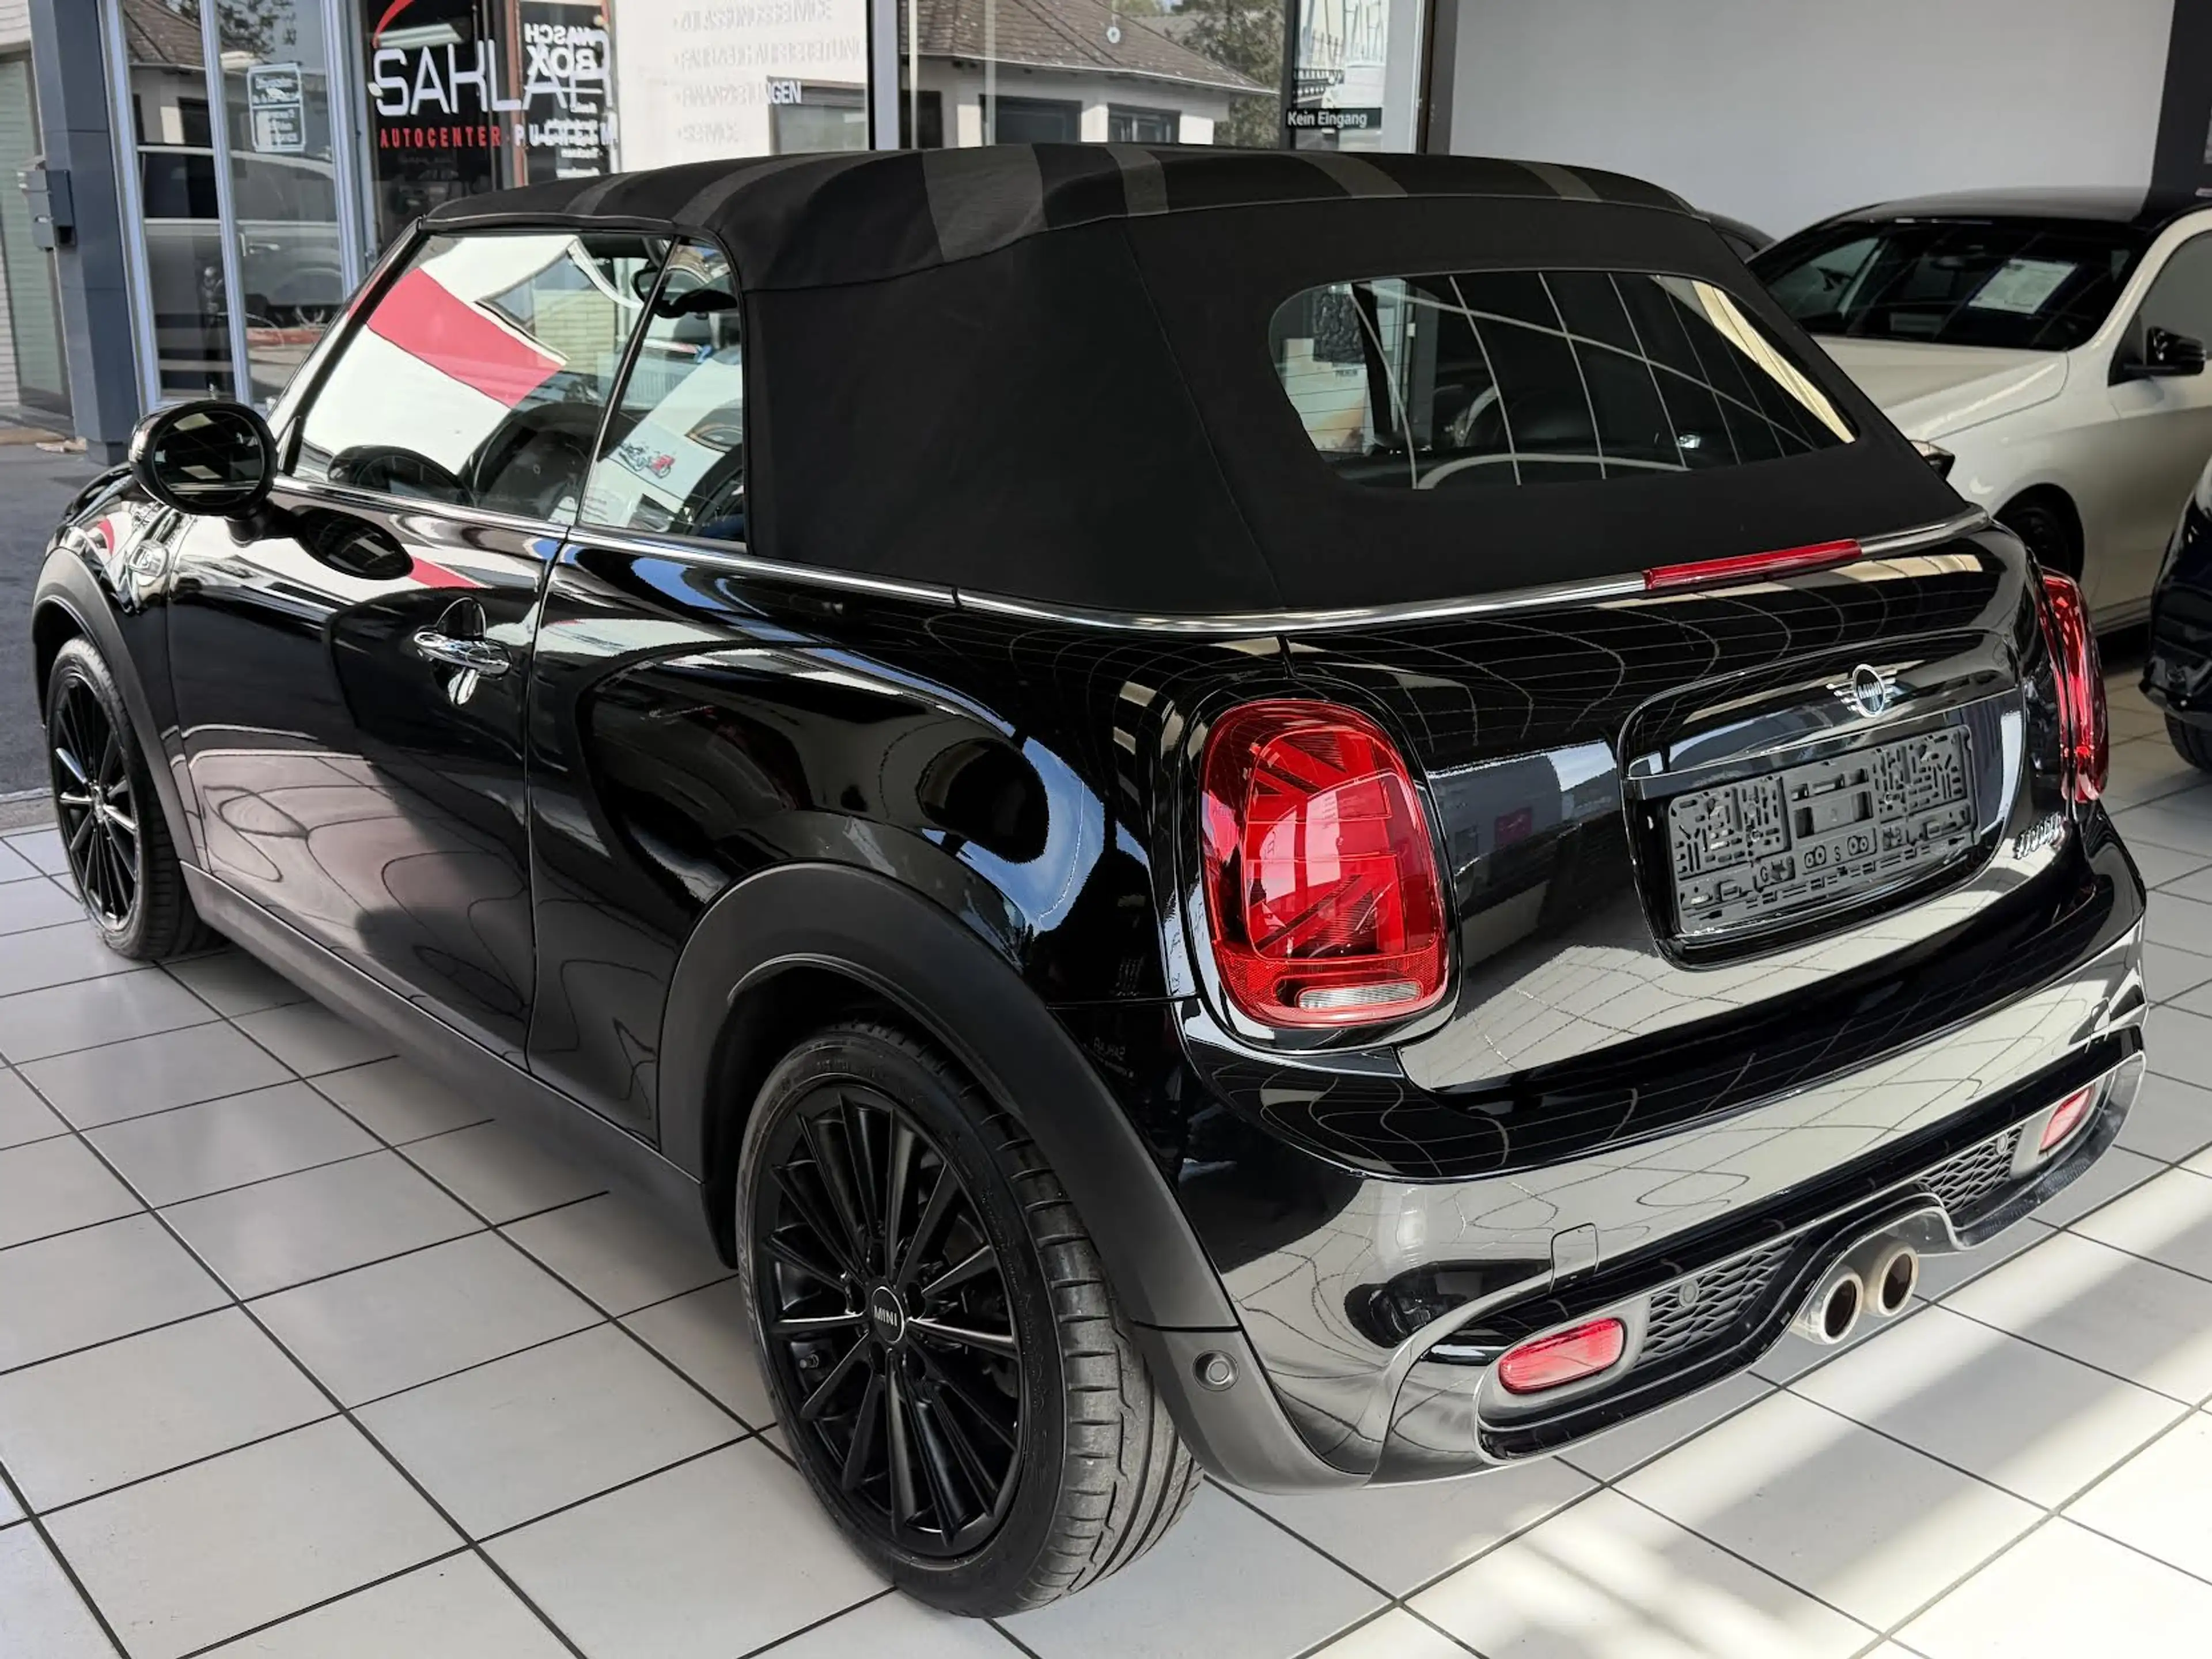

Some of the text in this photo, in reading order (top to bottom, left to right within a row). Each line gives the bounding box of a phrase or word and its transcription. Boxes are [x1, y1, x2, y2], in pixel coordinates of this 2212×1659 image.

[1287, 111, 1368, 128] Kein Eingang
[380, 124, 501, 149] AUTOCENTER
[874, 1304, 897, 1327] MINI
